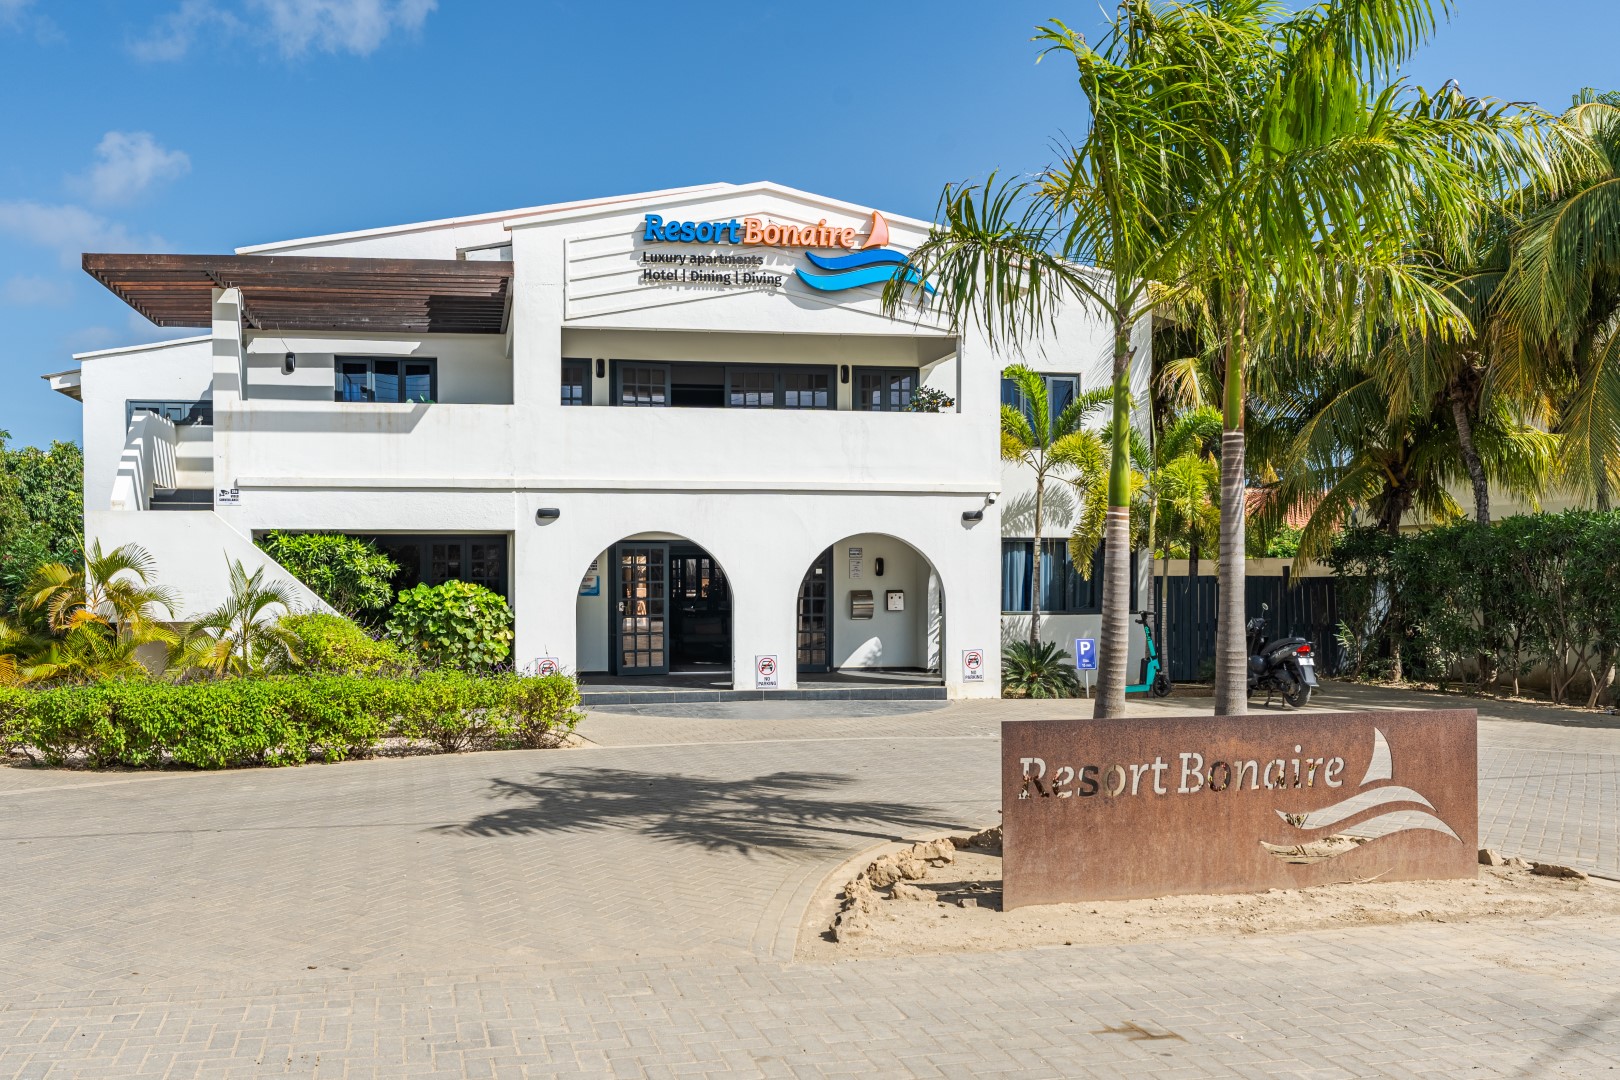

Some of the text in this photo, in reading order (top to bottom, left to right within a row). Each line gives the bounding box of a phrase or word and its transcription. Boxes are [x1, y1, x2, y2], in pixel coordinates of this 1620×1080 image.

[643, 214, 856, 249] Resort Bonaire
[643, 251, 764, 266] Luxury apartments
[643, 269, 678, 281] Hotel
[690, 270, 731, 285] Dining
[743, 272, 782, 287] Diving
[1080, 641, 1090, 655] P
[1018, 744, 1345, 799] Resort Bonaire
